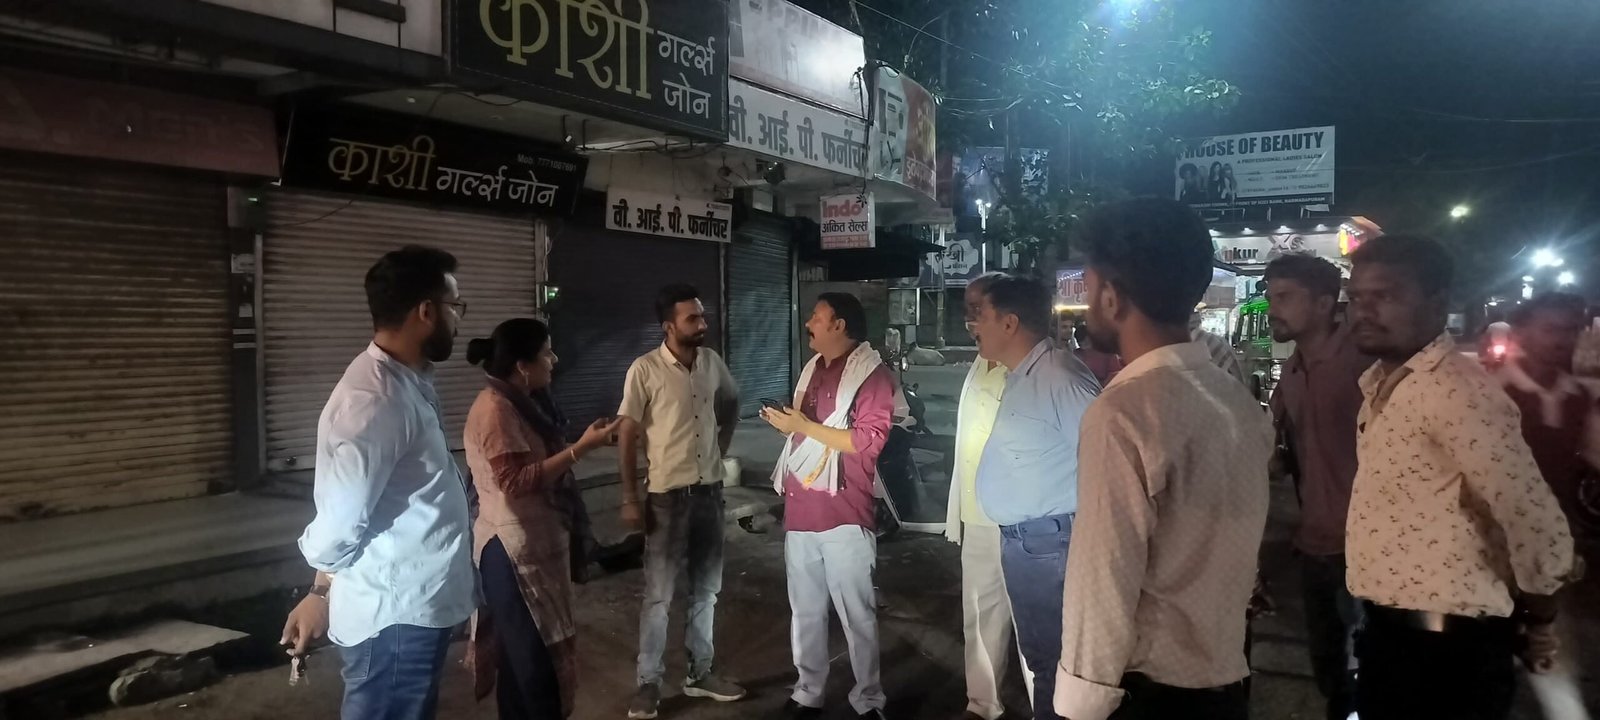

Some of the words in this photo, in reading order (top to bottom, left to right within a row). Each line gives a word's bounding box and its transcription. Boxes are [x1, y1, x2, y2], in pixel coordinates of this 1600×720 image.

[479, 0, 654, 99] काशी
[662, 73, 712, 118] जोन
[758, 111, 794, 156] आई.
[797, 117, 818, 161] पी.
[1238, 137, 1257, 155] OF
[1261, 131, 1324, 153] BEAUTY
[327, 135, 437, 191] काशी
[508, 170, 559, 207] जोन
[612, 198, 632, 228] वी.
[636, 204, 664, 233] आई.
[667, 206, 684, 234] पी.
[822, 199, 862, 218] Indo
